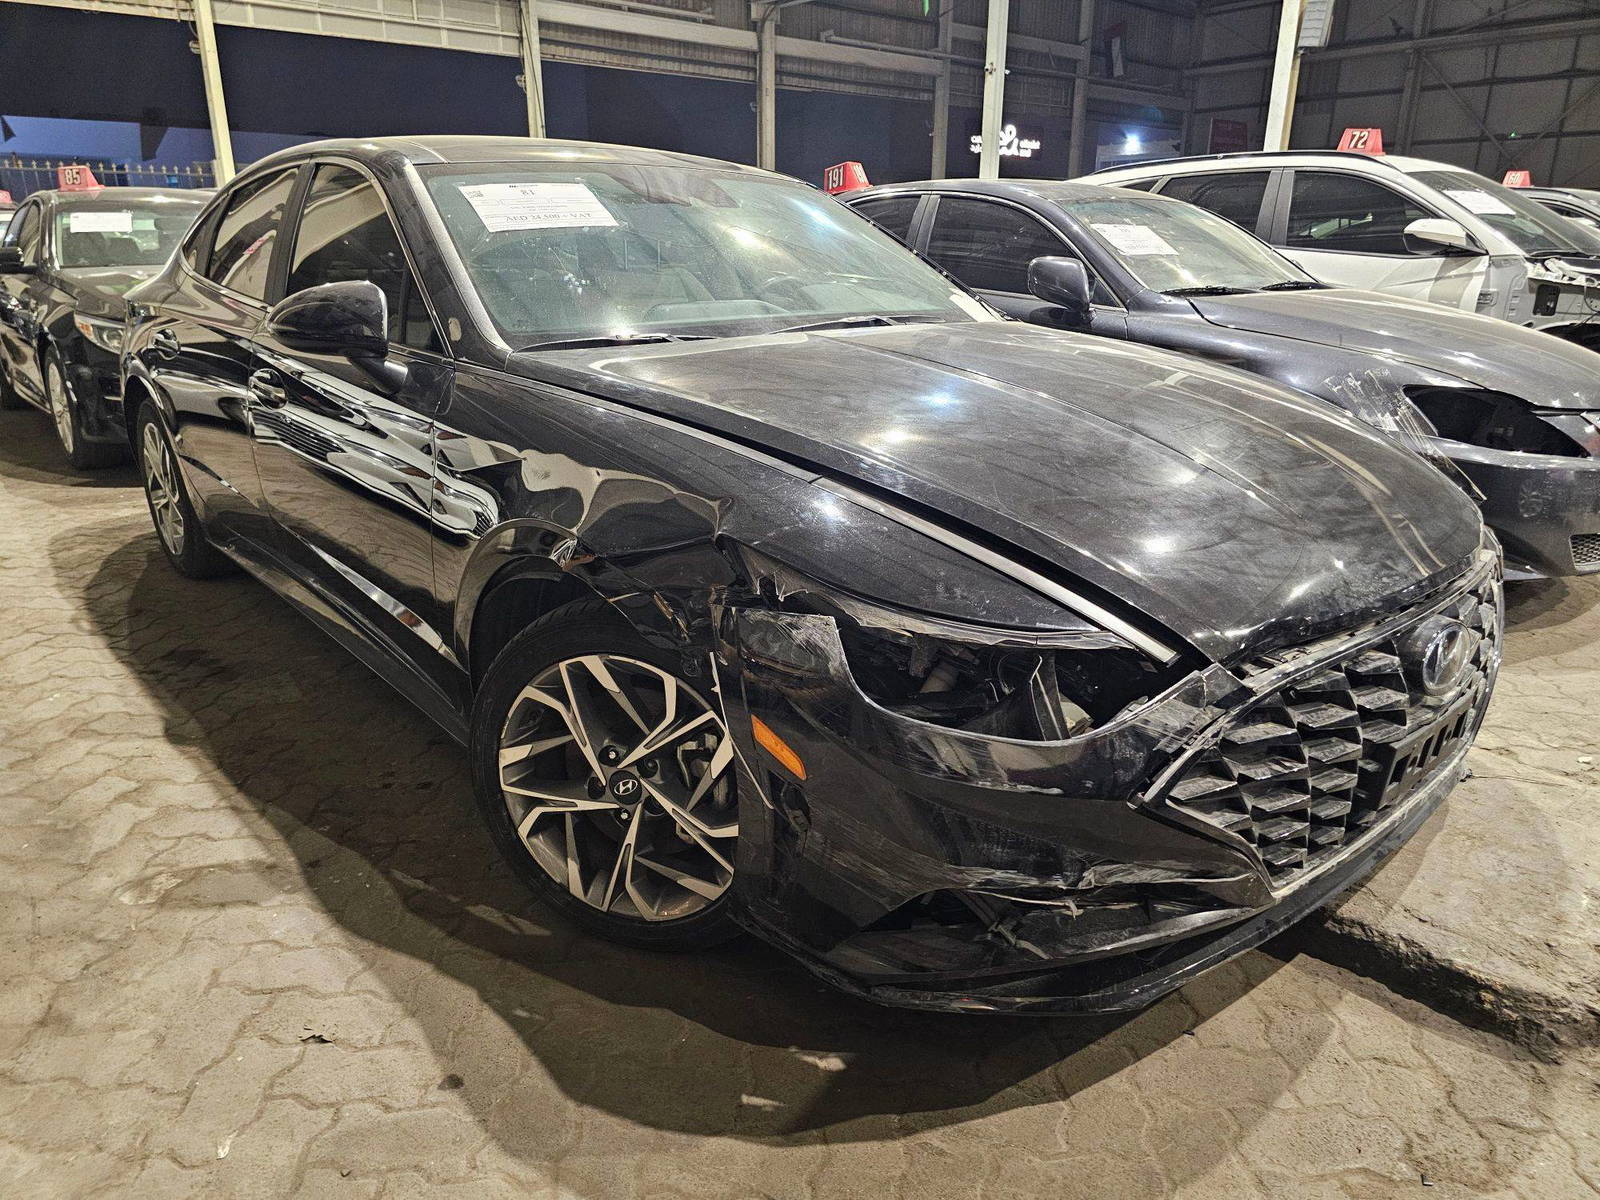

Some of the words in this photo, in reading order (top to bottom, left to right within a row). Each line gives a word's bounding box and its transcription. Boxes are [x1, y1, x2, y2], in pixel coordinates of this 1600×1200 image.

[1350, 130, 1368, 149] 72
[65, 169, 80, 185] 85
[829, 165, 844, 190] 191
